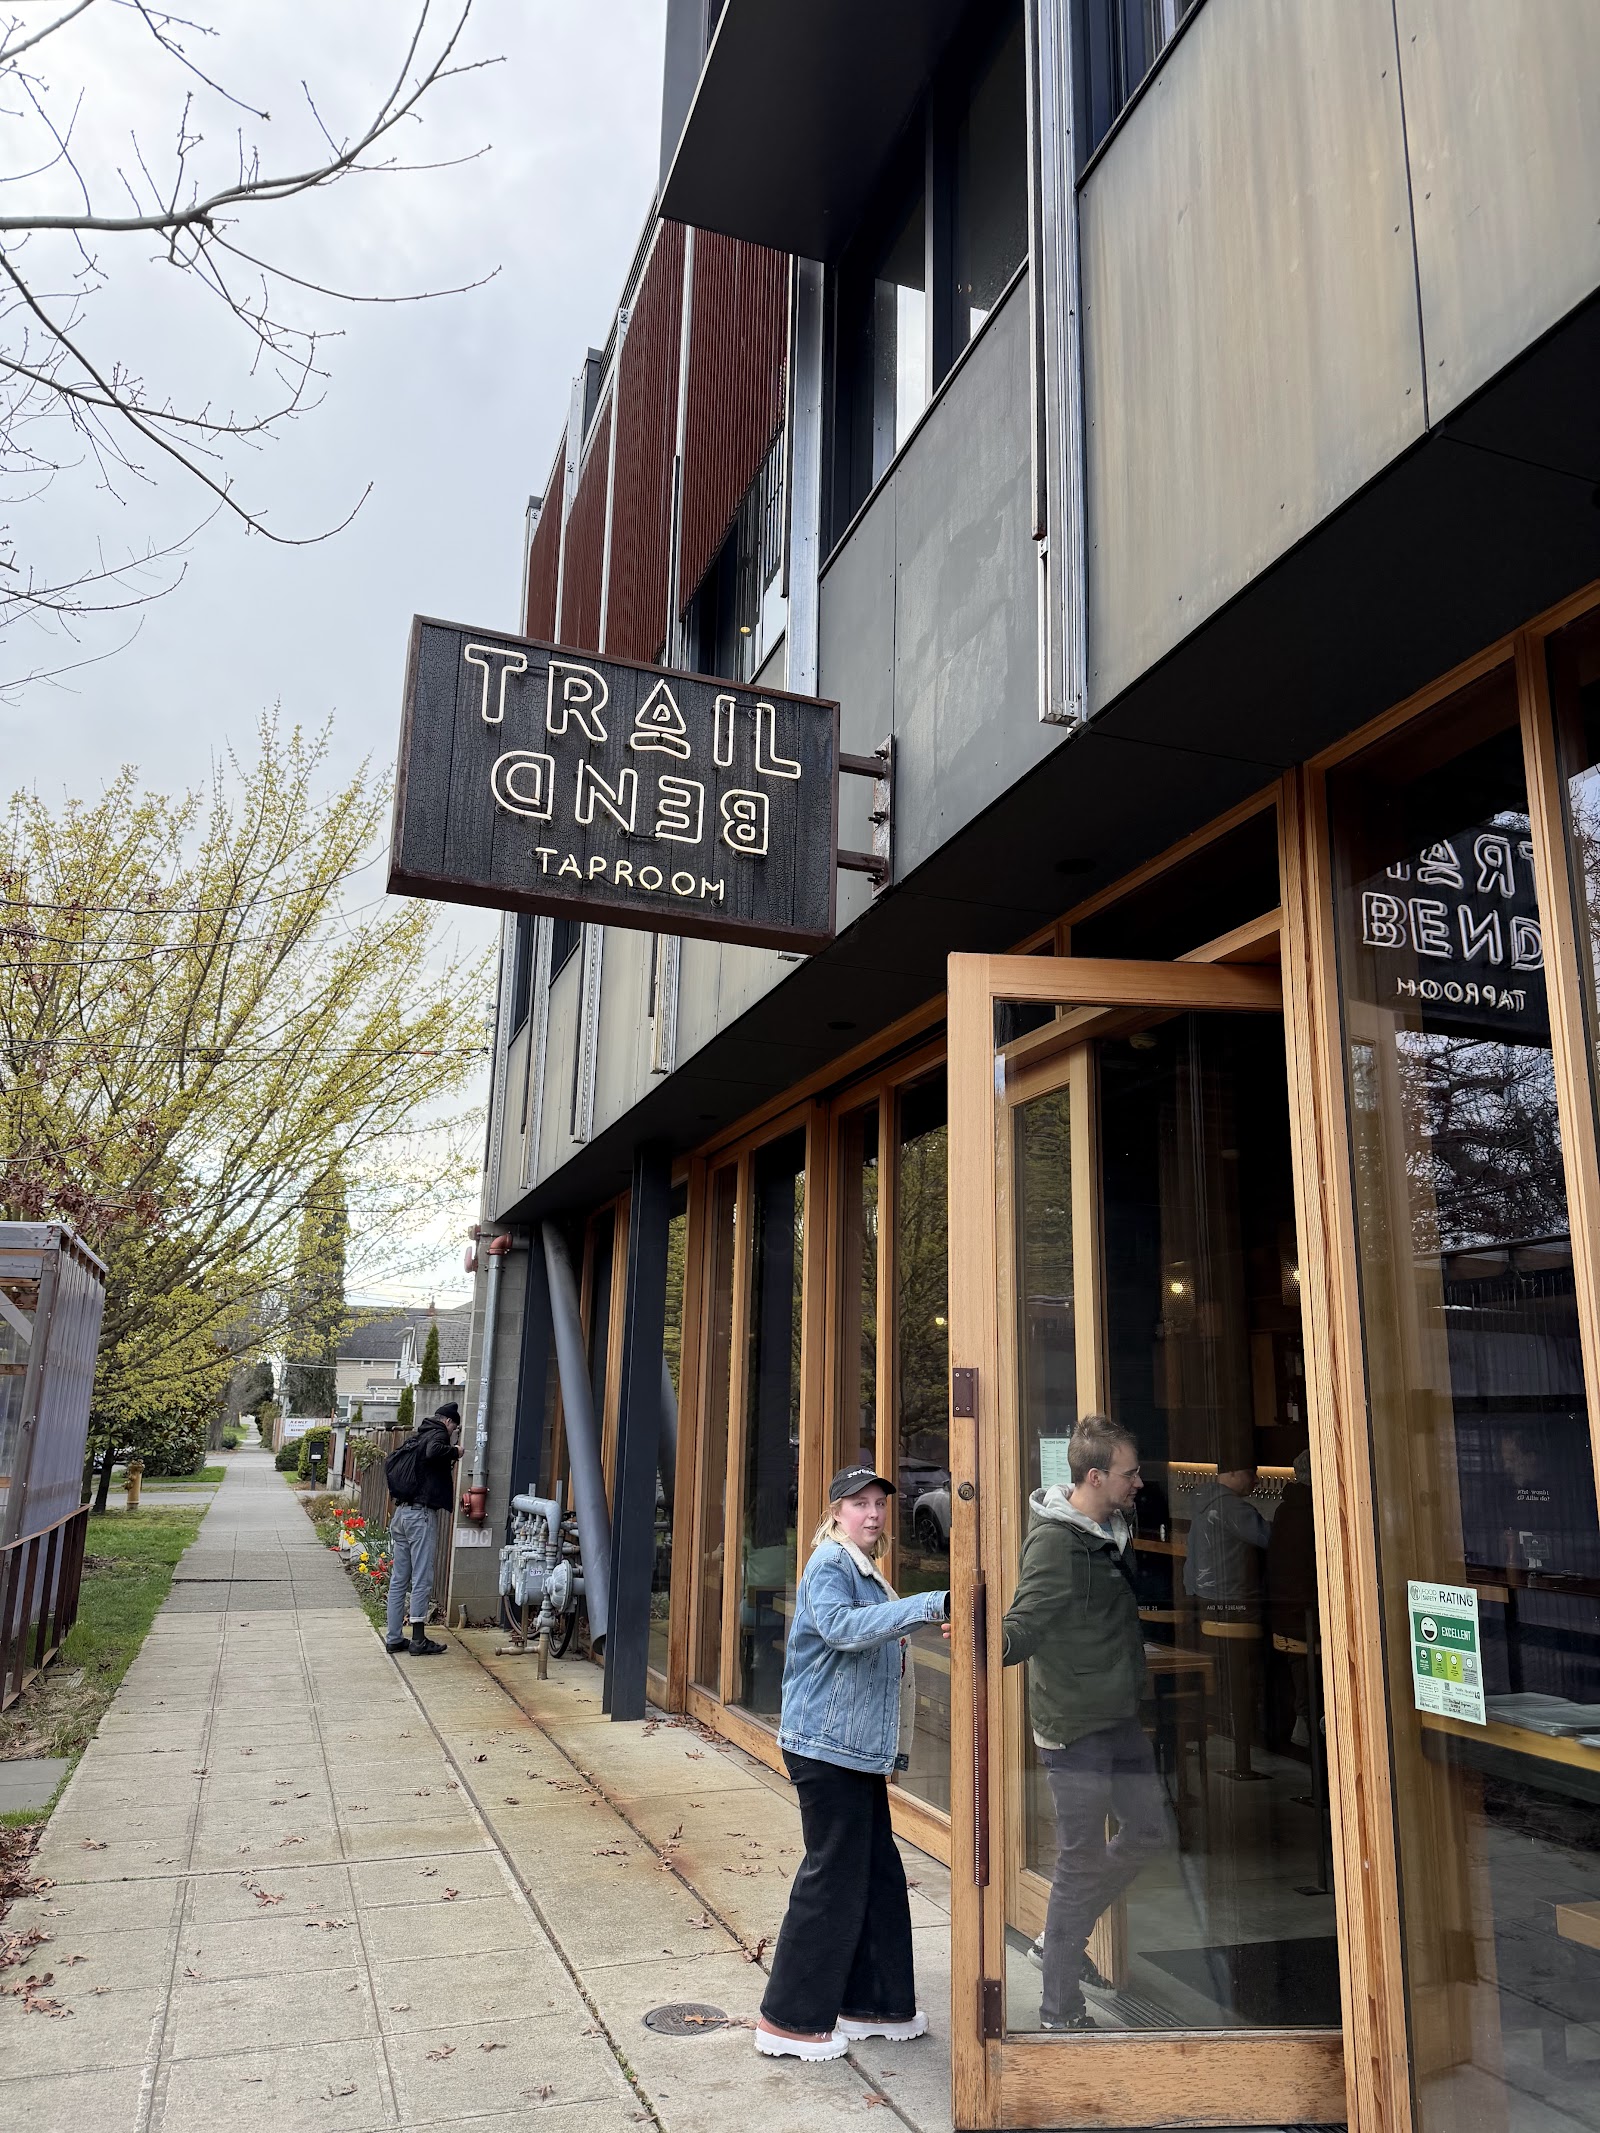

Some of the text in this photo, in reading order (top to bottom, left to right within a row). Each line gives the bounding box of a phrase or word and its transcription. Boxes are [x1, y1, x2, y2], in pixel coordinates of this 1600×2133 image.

[464, 643, 801, 779] TRAIL
[490, 750, 769, 855] BEND
[535, 847, 725, 900] TAPROOM
[460, 1529, 489, 1546] FDC
[1421, 1588, 1437, 1596] FOOD
[1422, 1594, 1438, 1602] SAFETY
[1439, 1590, 1474, 1607] RATING
[1441, 1626, 1472, 1641] EXCELLENT
